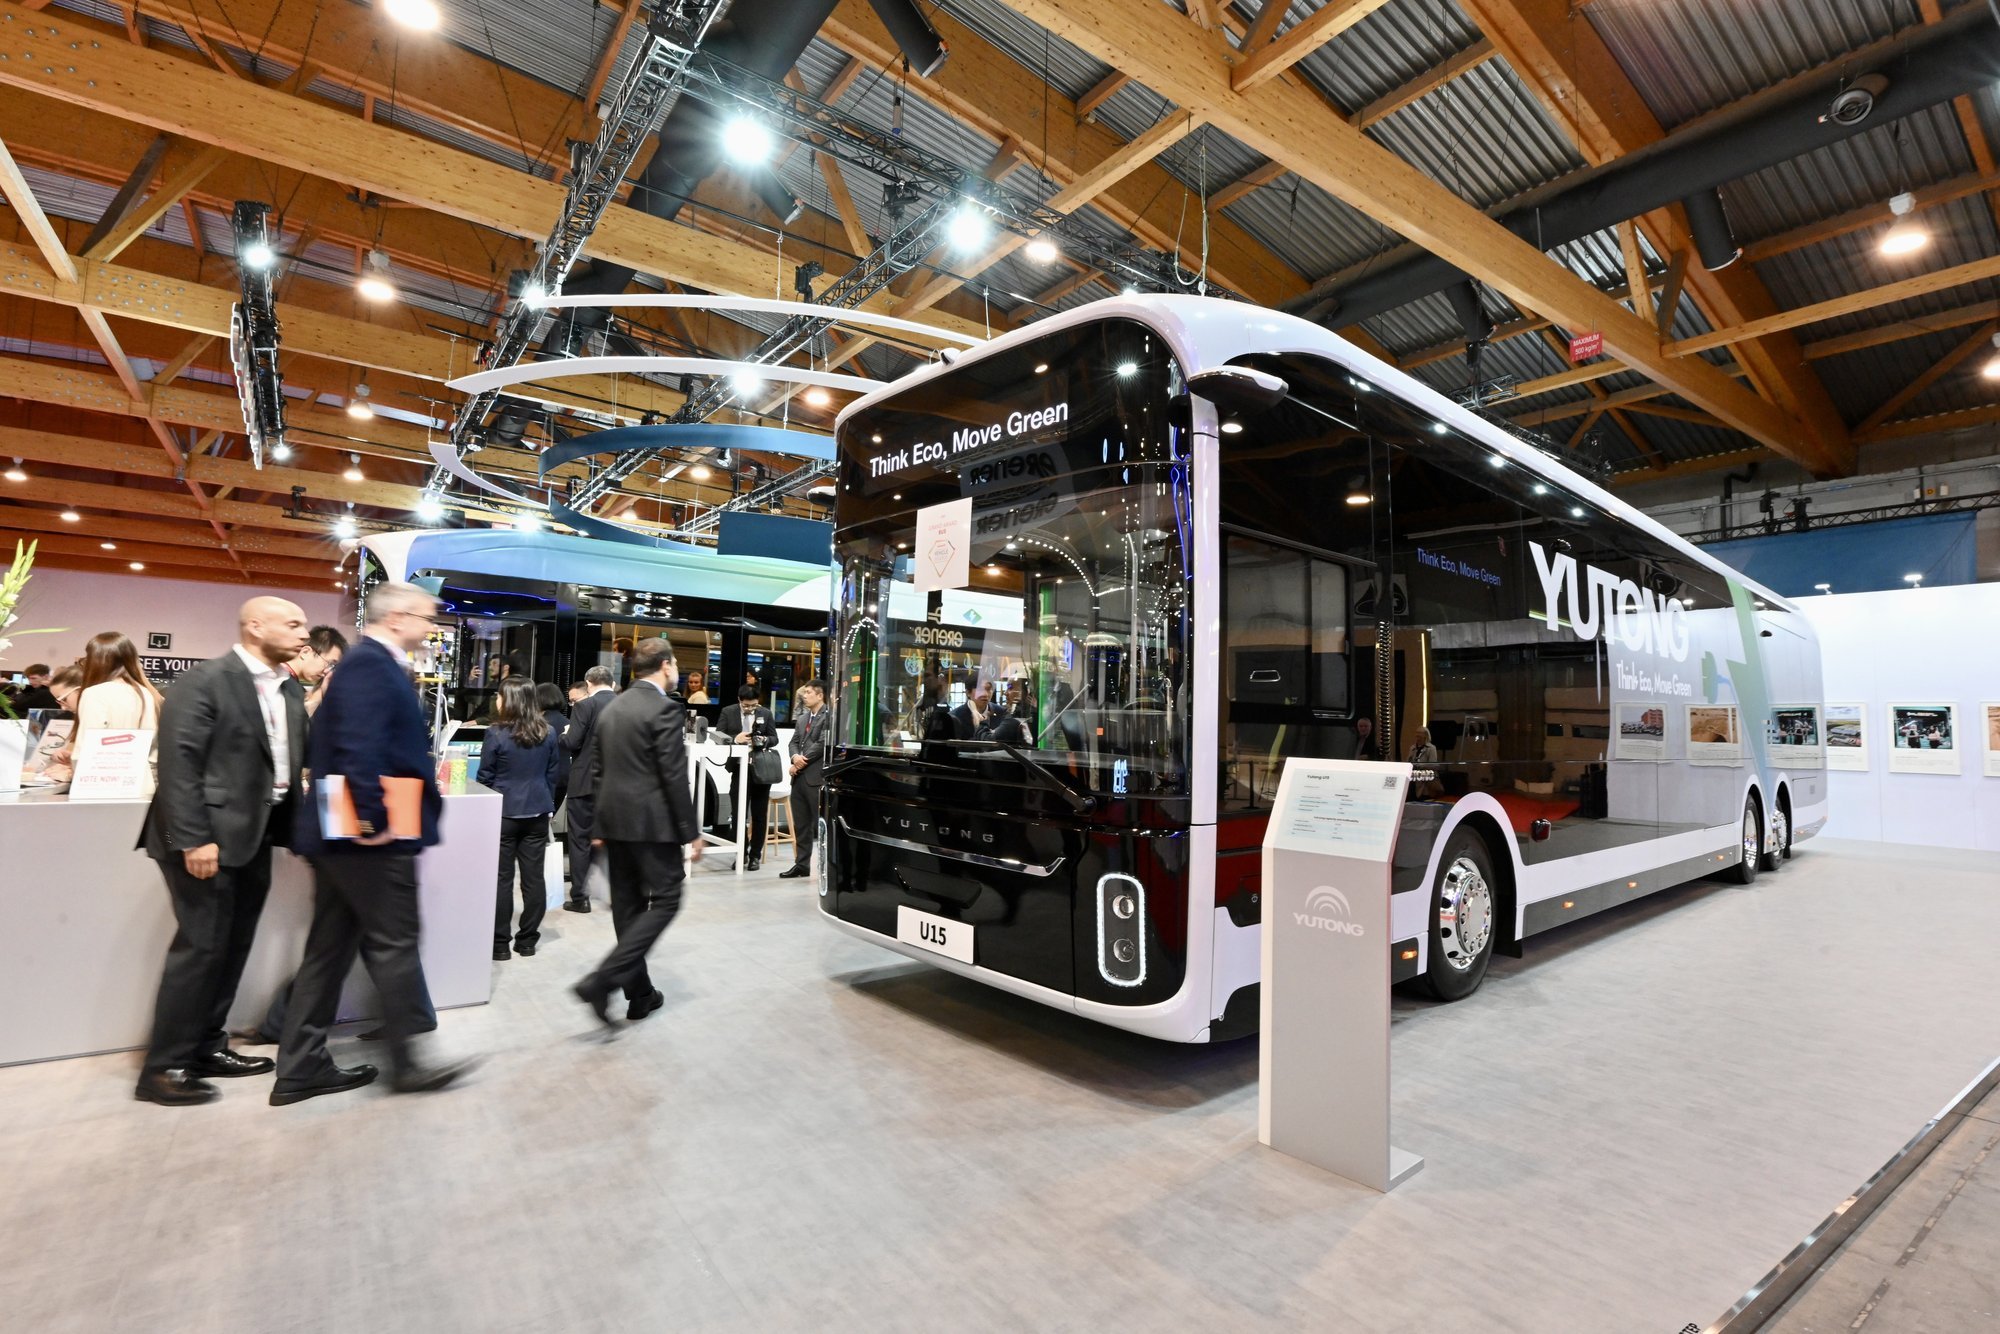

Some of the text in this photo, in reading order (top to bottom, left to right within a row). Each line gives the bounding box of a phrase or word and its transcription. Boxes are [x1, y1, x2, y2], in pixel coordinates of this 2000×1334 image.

[1574, 334, 1599, 346] MAXIMUM
[1575, 346, 1584, 355] 500
[869, 402, 1069, 478] Think Eco, Move Green
[1417, 547, 1501, 586] Think Eco, Move Green
[1528, 541, 1689, 662] YUTONG
[1616, 662, 1692, 697] Think Eco, Move Green
[883, 815, 995, 843] YUTONG
[920, 920, 947, 946] U15
[1291, 911, 1365, 937] YUTONG
